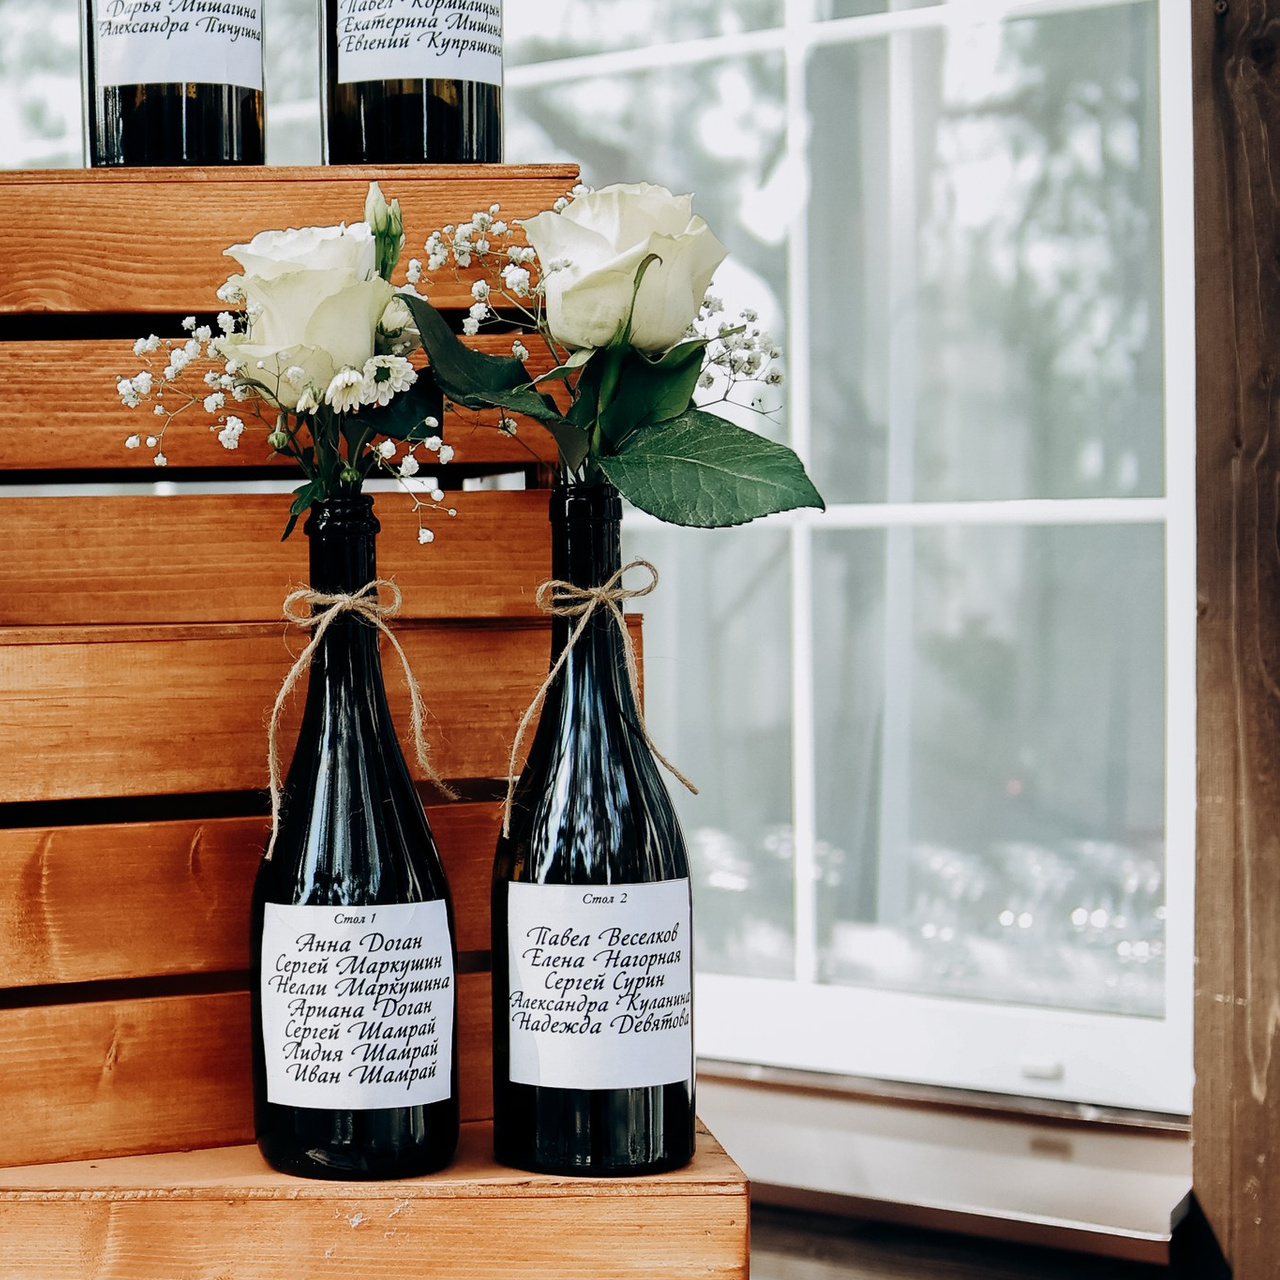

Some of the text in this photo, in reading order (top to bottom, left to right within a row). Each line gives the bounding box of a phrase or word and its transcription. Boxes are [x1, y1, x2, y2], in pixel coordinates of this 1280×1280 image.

[106, 0, 161, 21] Дарья
[99, 16, 261, 42] Александра Пичугина
[337, 13, 438, 36] Екатерина
[337, 33, 410, 53] Евгений
[582, 893, 627, 904] Стол 2
[334, 913, 376, 924] Стол 1
[296, 932, 423, 953] Анна Доган
[526, 922, 680, 947] Павел Веселков
[276, 954, 443, 982] Сергей Маркушин
[522, 948, 681, 974] Елена Нагорная
[268, 975, 450, 1005] Нелли Маркушина
[545, 971, 665, 1001] Сергей Сурин
[288, 998, 433, 1026] Ариана Доган
[509, 990, 690, 1020] Александра Куланина
[285, 1017, 437, 1047] Сергей Шамрай
[512, 1008, 689, 1035] Надежда Девятова
[283, 1038, 439, 1068] Лидия Шамрай
[286, 1061, 437, 1091] Иван Шамрай
